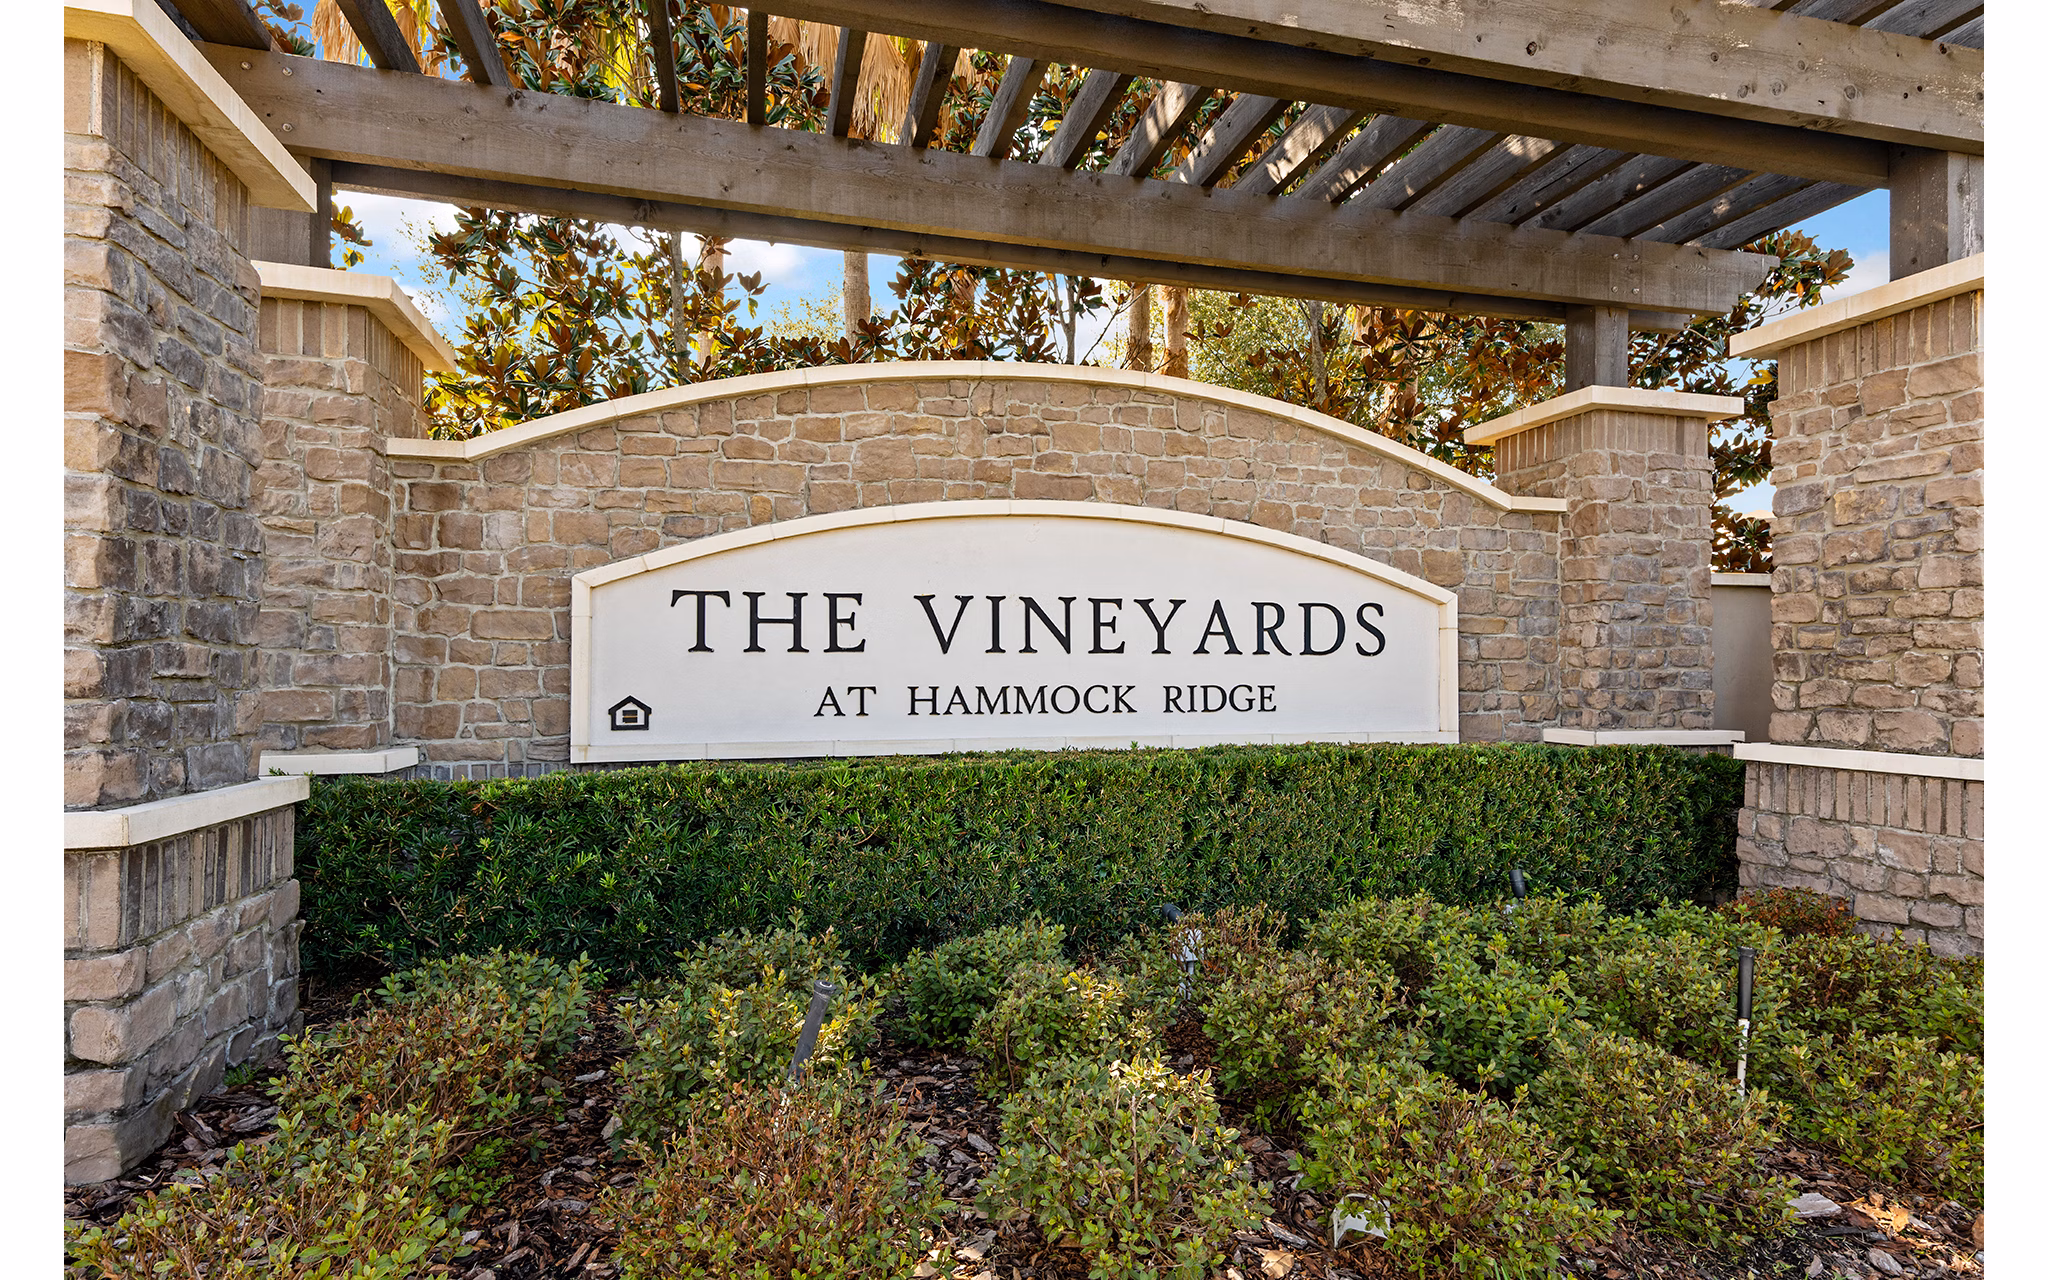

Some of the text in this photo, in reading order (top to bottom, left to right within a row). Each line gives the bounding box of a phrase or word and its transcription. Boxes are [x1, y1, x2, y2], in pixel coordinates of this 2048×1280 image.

[670, 589, 1387, 658] THE VINEYARDS
[813, 684, 1277, 718] AT HAMMOCK RIDGE
